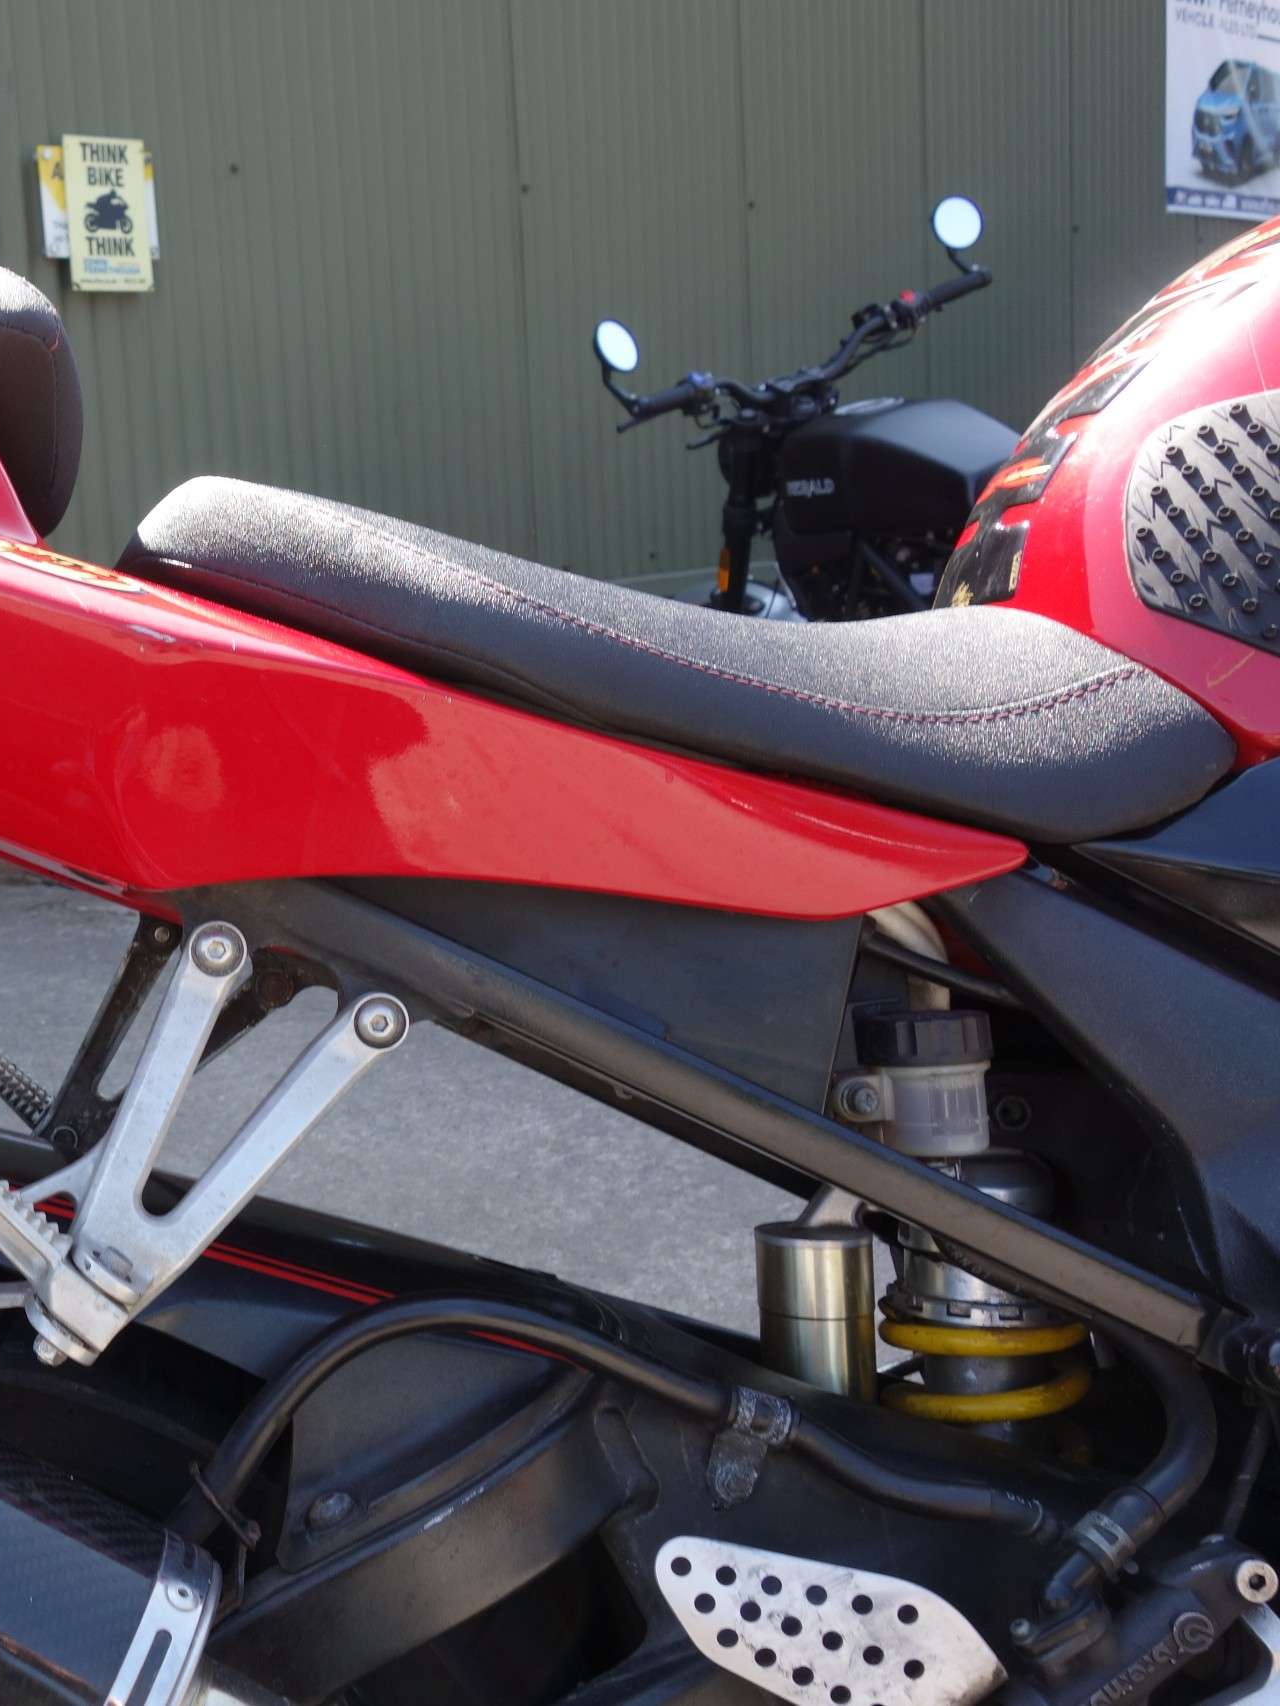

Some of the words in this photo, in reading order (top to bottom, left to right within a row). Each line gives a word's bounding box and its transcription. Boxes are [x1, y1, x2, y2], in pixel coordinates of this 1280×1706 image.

[80, 142, 129, 166] THINK
[87, 166, 125, 188] BIKE
[86, 236, 135, 257] THINK
[785, 478, 836, 498] HERALD
